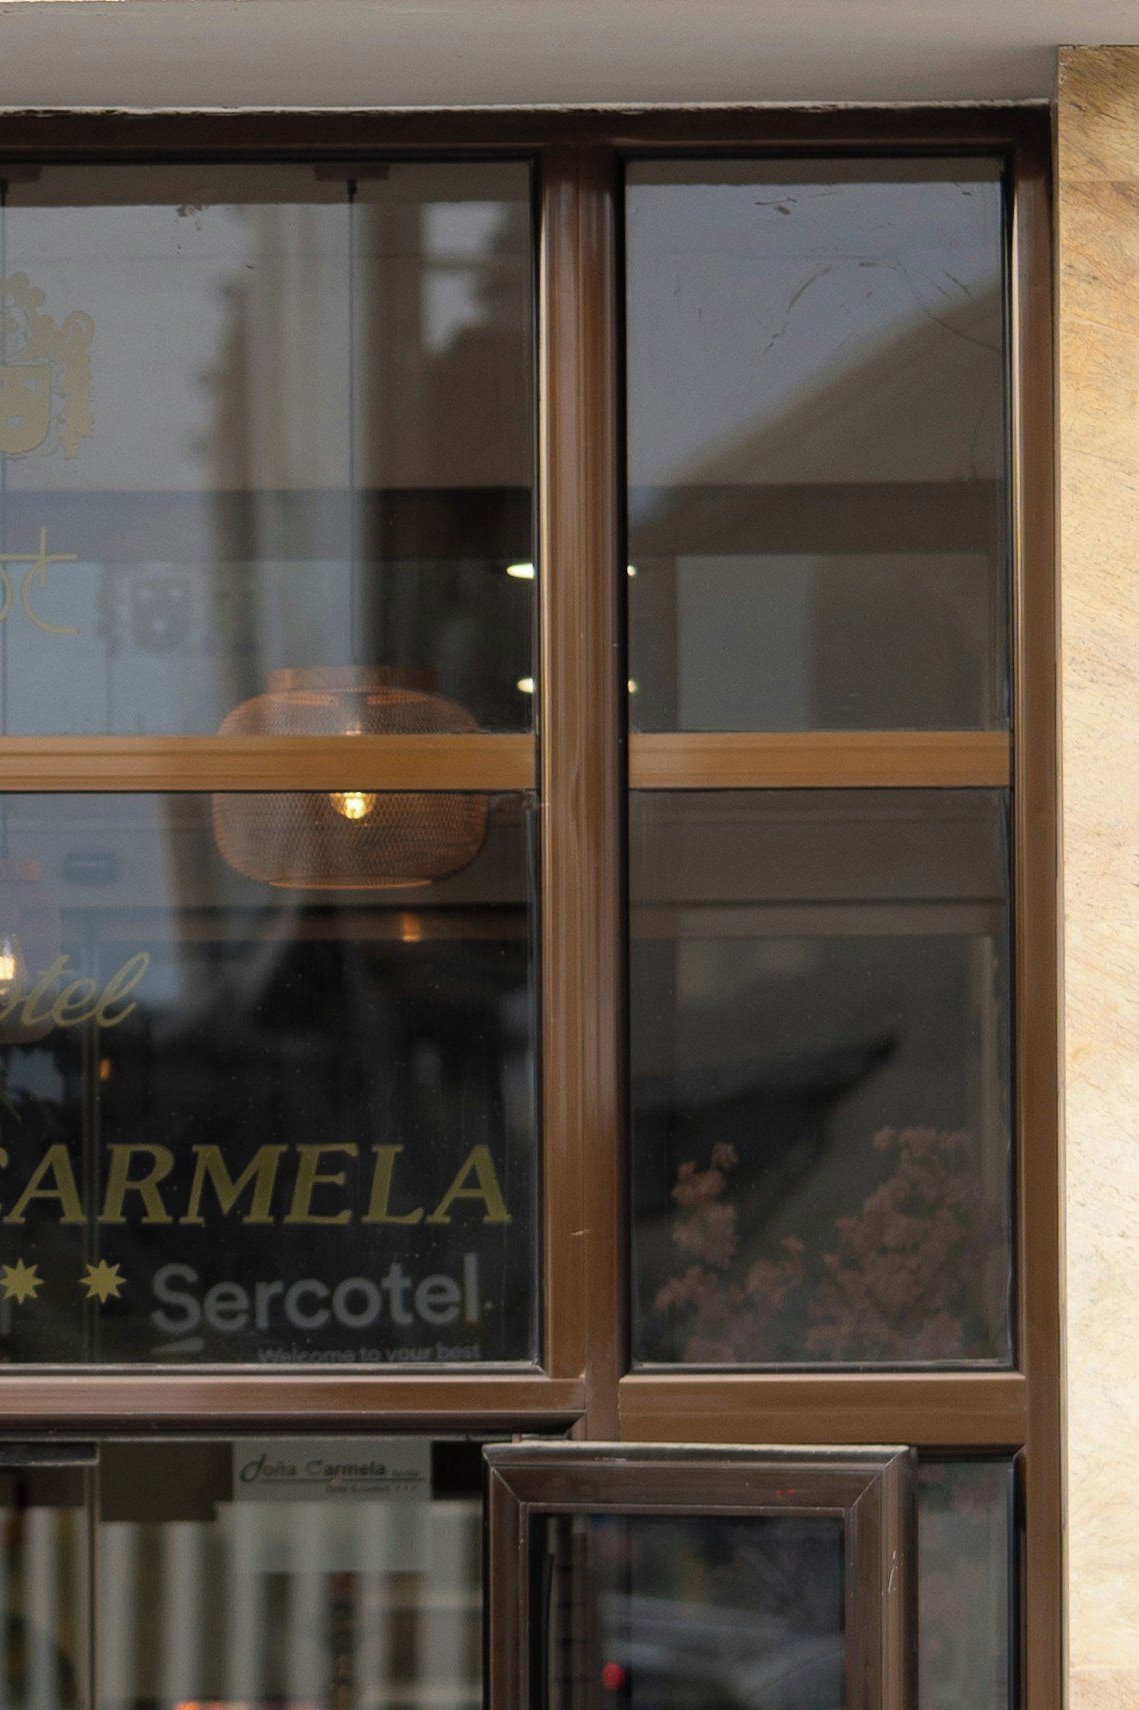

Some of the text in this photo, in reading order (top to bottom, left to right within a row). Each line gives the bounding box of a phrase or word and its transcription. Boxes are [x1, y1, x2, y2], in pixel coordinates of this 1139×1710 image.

[150, 1252, 478, 1335] Sercotel
[257, 1342, 481, 1362] Welcome to your best
[306, 1458, 387, 1478] Carmela
